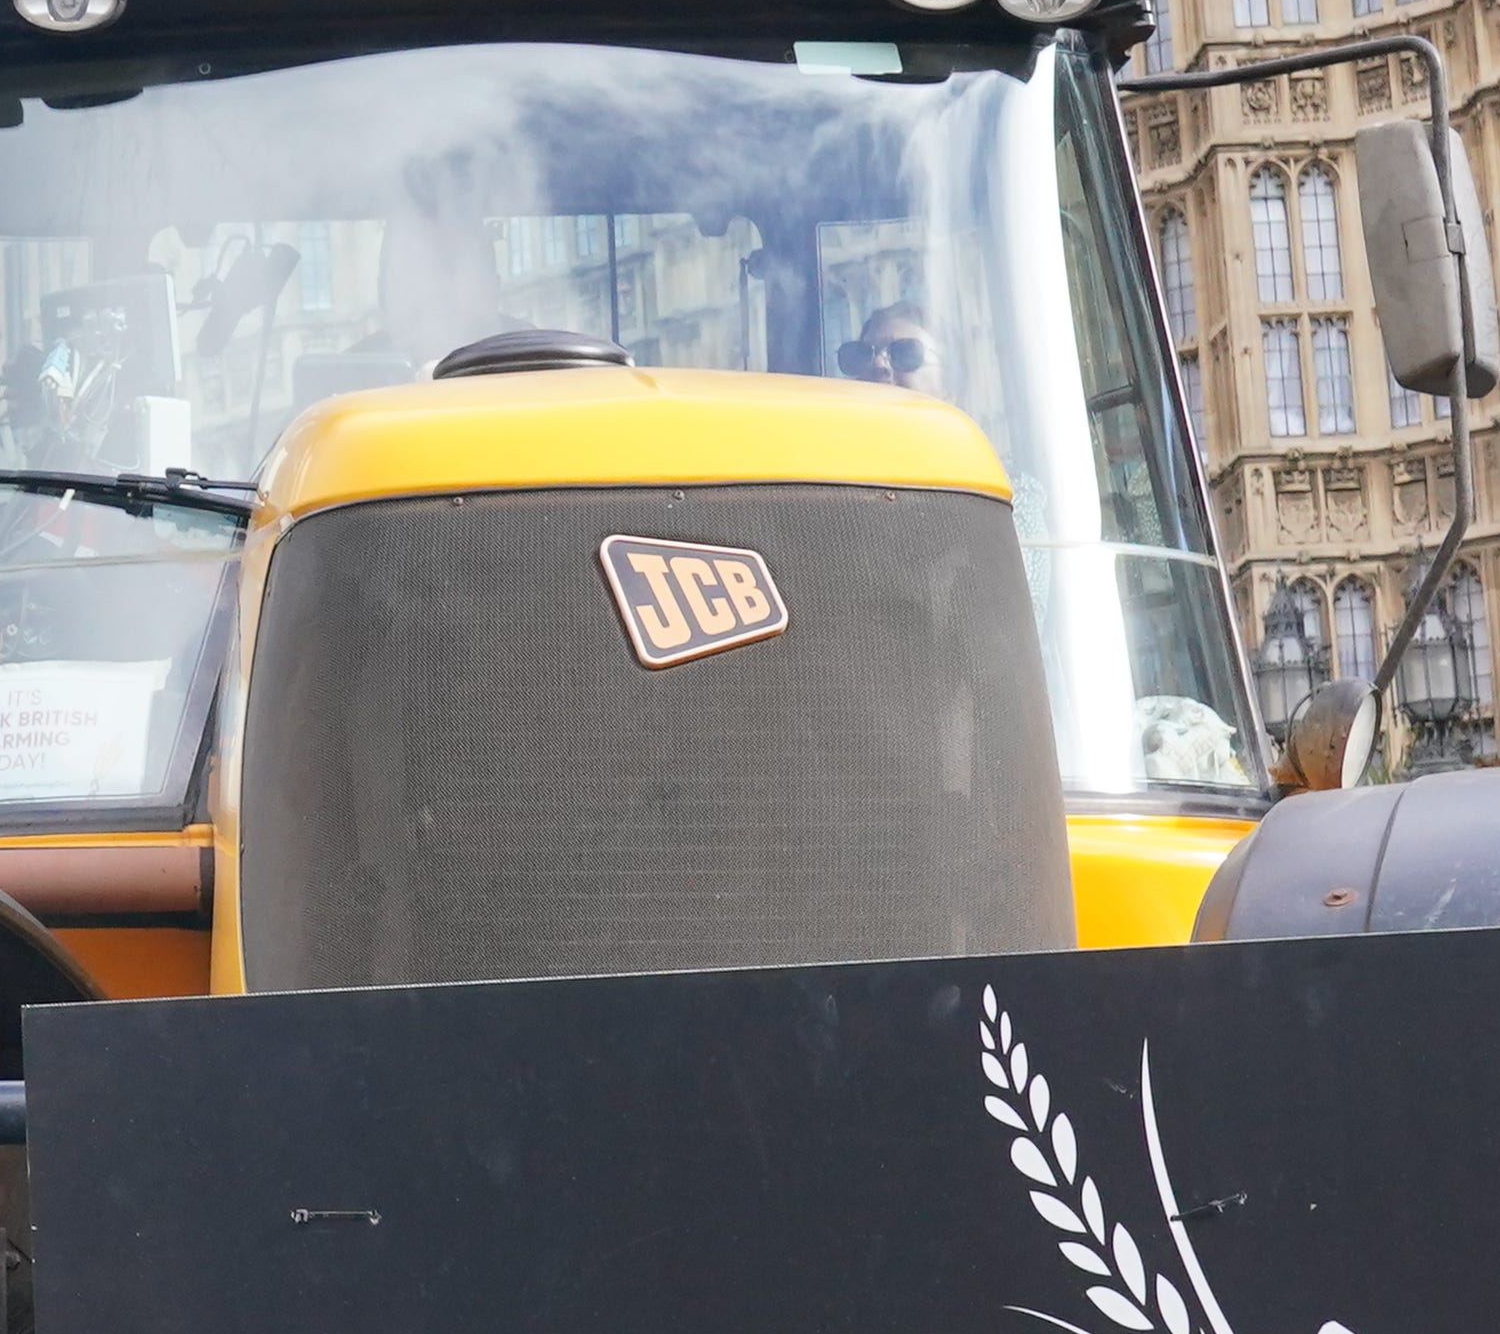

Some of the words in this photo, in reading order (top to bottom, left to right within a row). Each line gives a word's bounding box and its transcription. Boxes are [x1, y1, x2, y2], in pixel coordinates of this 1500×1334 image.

[626, 552, 771, 649] JCB
[8, 689, 42, 707] IT'S
[18, 710, 99, 729] BRITISH
